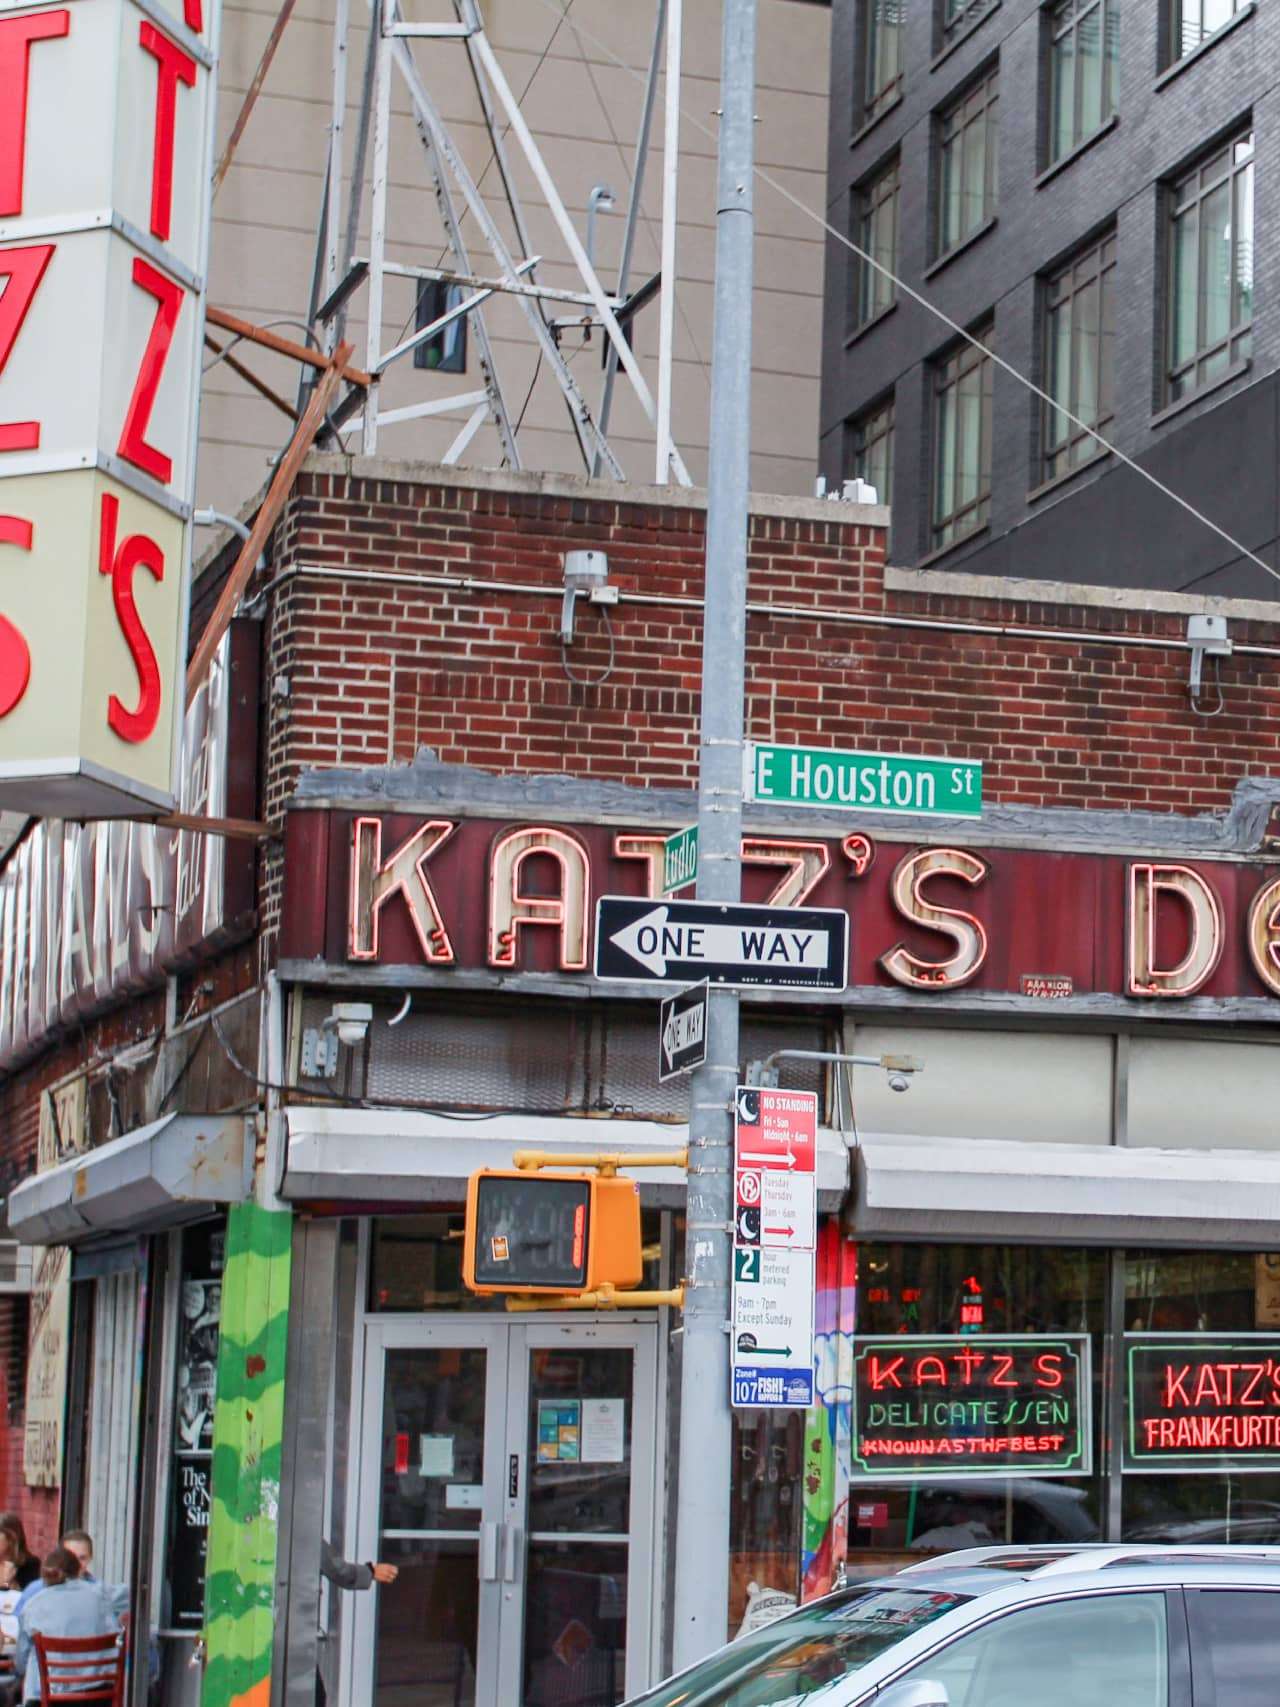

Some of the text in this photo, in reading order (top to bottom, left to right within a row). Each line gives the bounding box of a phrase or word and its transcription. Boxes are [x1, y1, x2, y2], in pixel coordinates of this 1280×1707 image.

[757, 751, 974, 809] E Houston St
[665, 838, 700, 886] Ludlo
[637, 926, 813, 963] ONE WAY
[667, 1006, 702, 1053] ONE WAY
[763, 1096, 815, 1113] NO STANDING
[763, 1128, 790, 1143] Midnight
[741, 1249, 755, 1280] 2
[763, 1263, 790, 1275] metered
[763, 1275, 787, 1287] parking
[738, 1296, 777, 1311] 9am 7pm
[737, 1311, 793, 1328] Except Sunday
[735, 1381, 758, 1403] 107
[868, 1400, 1070, 1427] DELICATESSEN
[862, 1438, 936, 1456] KNOWN
[937, 1438, 965, 1455] AS
[1010, 1434, 1065, 1452] BEST
[181, 1465, 207, 1490] The
[183, 1487, 197, 1507] of
